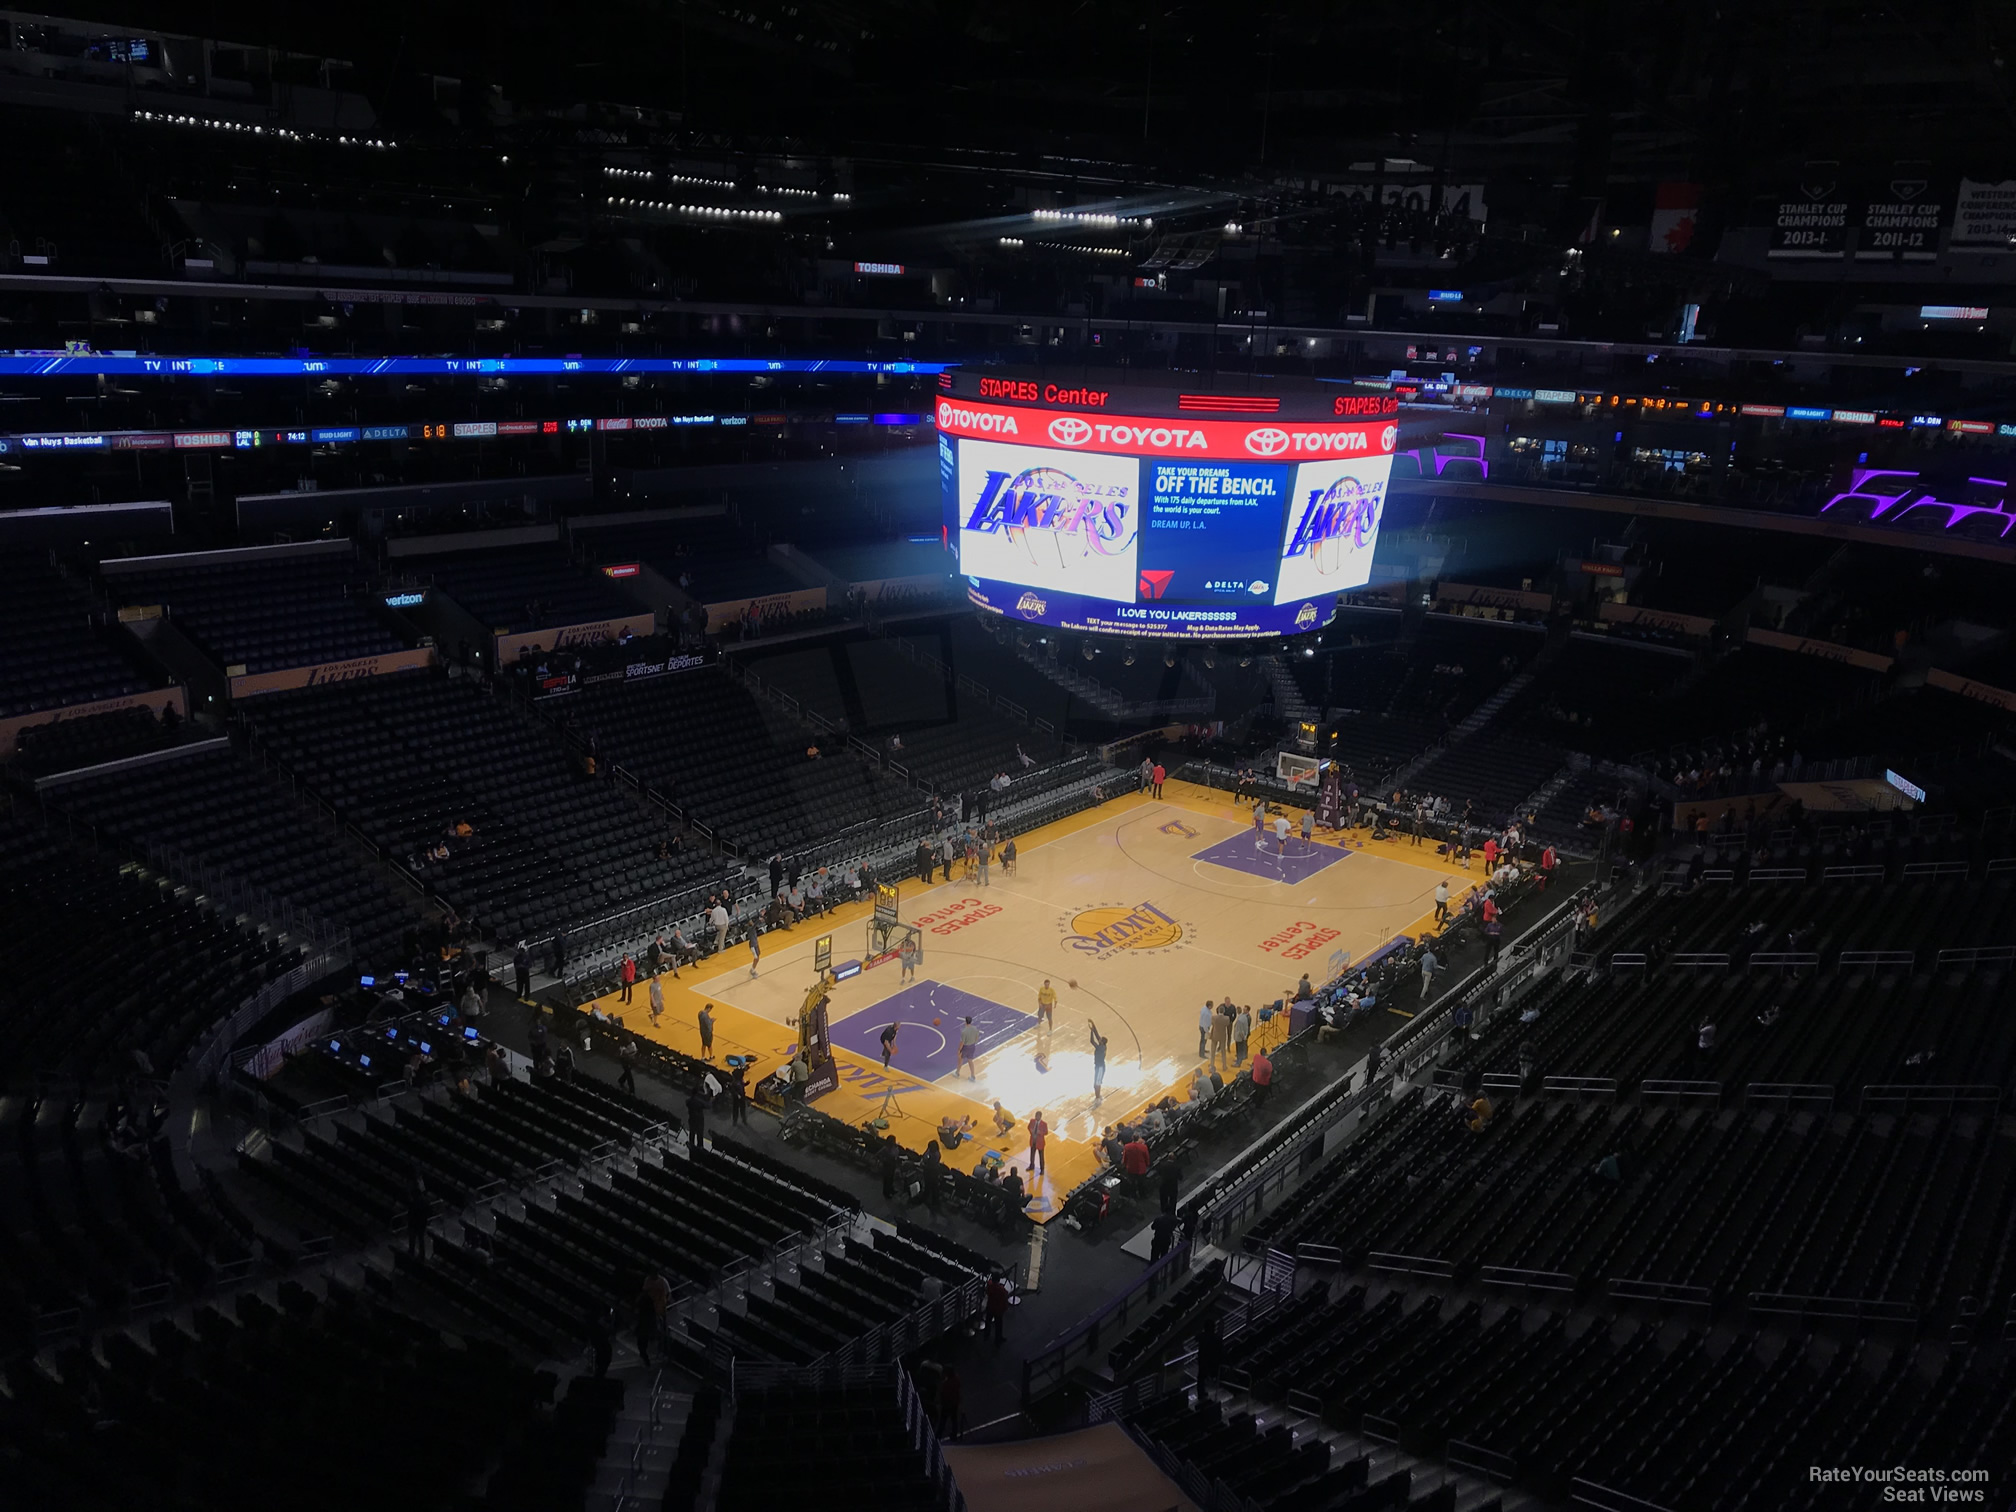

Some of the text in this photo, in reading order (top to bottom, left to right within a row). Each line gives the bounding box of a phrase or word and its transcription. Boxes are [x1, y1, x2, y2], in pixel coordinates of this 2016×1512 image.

[1779, 204, 1848, 214] STANLEY CUP
[1867, 204, 1941, 215] STANLEY CUP
[1777, 215, 1845, 227] CHAMPIONS
[1866, 216, 1938, 228] CHAMPIONS
[1784, 231, 1829, 245] 2013-1
[1873, 232, 1924, 246] 2011-12
[858, 263, 901, 273] TOSHIBA
[144, 361, 161, 370] TV
[447, 361, 459, 369] TV
[672, 361, 682, 369] TV
[980, 378, 1108, 406] STAPLES Center
[1505, 389, 1533, 398] DELTA
[1537, 391, 1574, 401] STAPLES
[1335, 397, 1380, 415] STAPLES
[567, 419, 577, 427] LAL
[634, 418, 667, 428] TOYOTA
[721, 416, 747, 425] verizon
[953, 409, 1018, 435] TOYOTA
[1834, 410, 1875, 423] TOSHIBA
[236, 431, 252, 439] DEN
[319, 431, 353, 439] BUD LIGHT
[374, 429, 407, 437] DELTA
[423, 425, 446, 438] 6:18
[455, 423, 496, 435] STAPLES
[23, 436, 103, 447] Van Nuys Basketball
[176, 434, 230, 447] TOSHIBA
[1096, 425, 1207, 449] TOYOTA
[1292, 432, 1368, 451] TOYOTA
[1157, 467, 1230, 477] TAKE YOUR DREAMS
[1156, 476, 1276, 496] OFF THE BENCH.
[1154, 496, 1259, 507] With 175 daily departures from LAX,
[962, 470, 1138, 556] LAKERS
[1153, 505, 1163, 513] the
[1164, 505, 1181, 514] world
[1189, 506, 1202, 515] your
[1203, 506, 1221, 515] court.
[1151, 520, 1206, 530] DREAM UP, L.A.
[1282, 488, 1382, 559] LAKERS
[1214, 581, 1244, 589] DELTA
[385, 592, 422, 607] verizon
[1016, 596, 1048, 616] LAKERS
[1122, 608, 1147, 618] LOVE
[1149, 609, 1170, 619] YOU
[1071, 622, 1088, 631] Lakers
[1099, 626, 1120, 634] confirm
[1121, 628, 1140, 636] receipt
[1257, 630, 1281, 638] participate
[1086, 617, 1100, 625] TEXT
[1114, 621, 1138, 629] message
[1187, 624, 1198, 632] Msg
[1245, 624, 1260, 632] Apply.
[626, 663, 665, 677] SPORTSNET
[668, 656, 703, 671] DEPORTES
[542, 676, 567, 688] ESPN
[568, 674, 577, 684] LA
[911, 898, 983, 928] Center
[931, 904, 1003, 936] STAPLES
[1061, 899, 1180, 957] LAKERS
[1257, 921, 1318, 952] Center
[1281, 927, 1342, 960] STAPLES
[804, 1076, 831, 1094] ECHANGA
